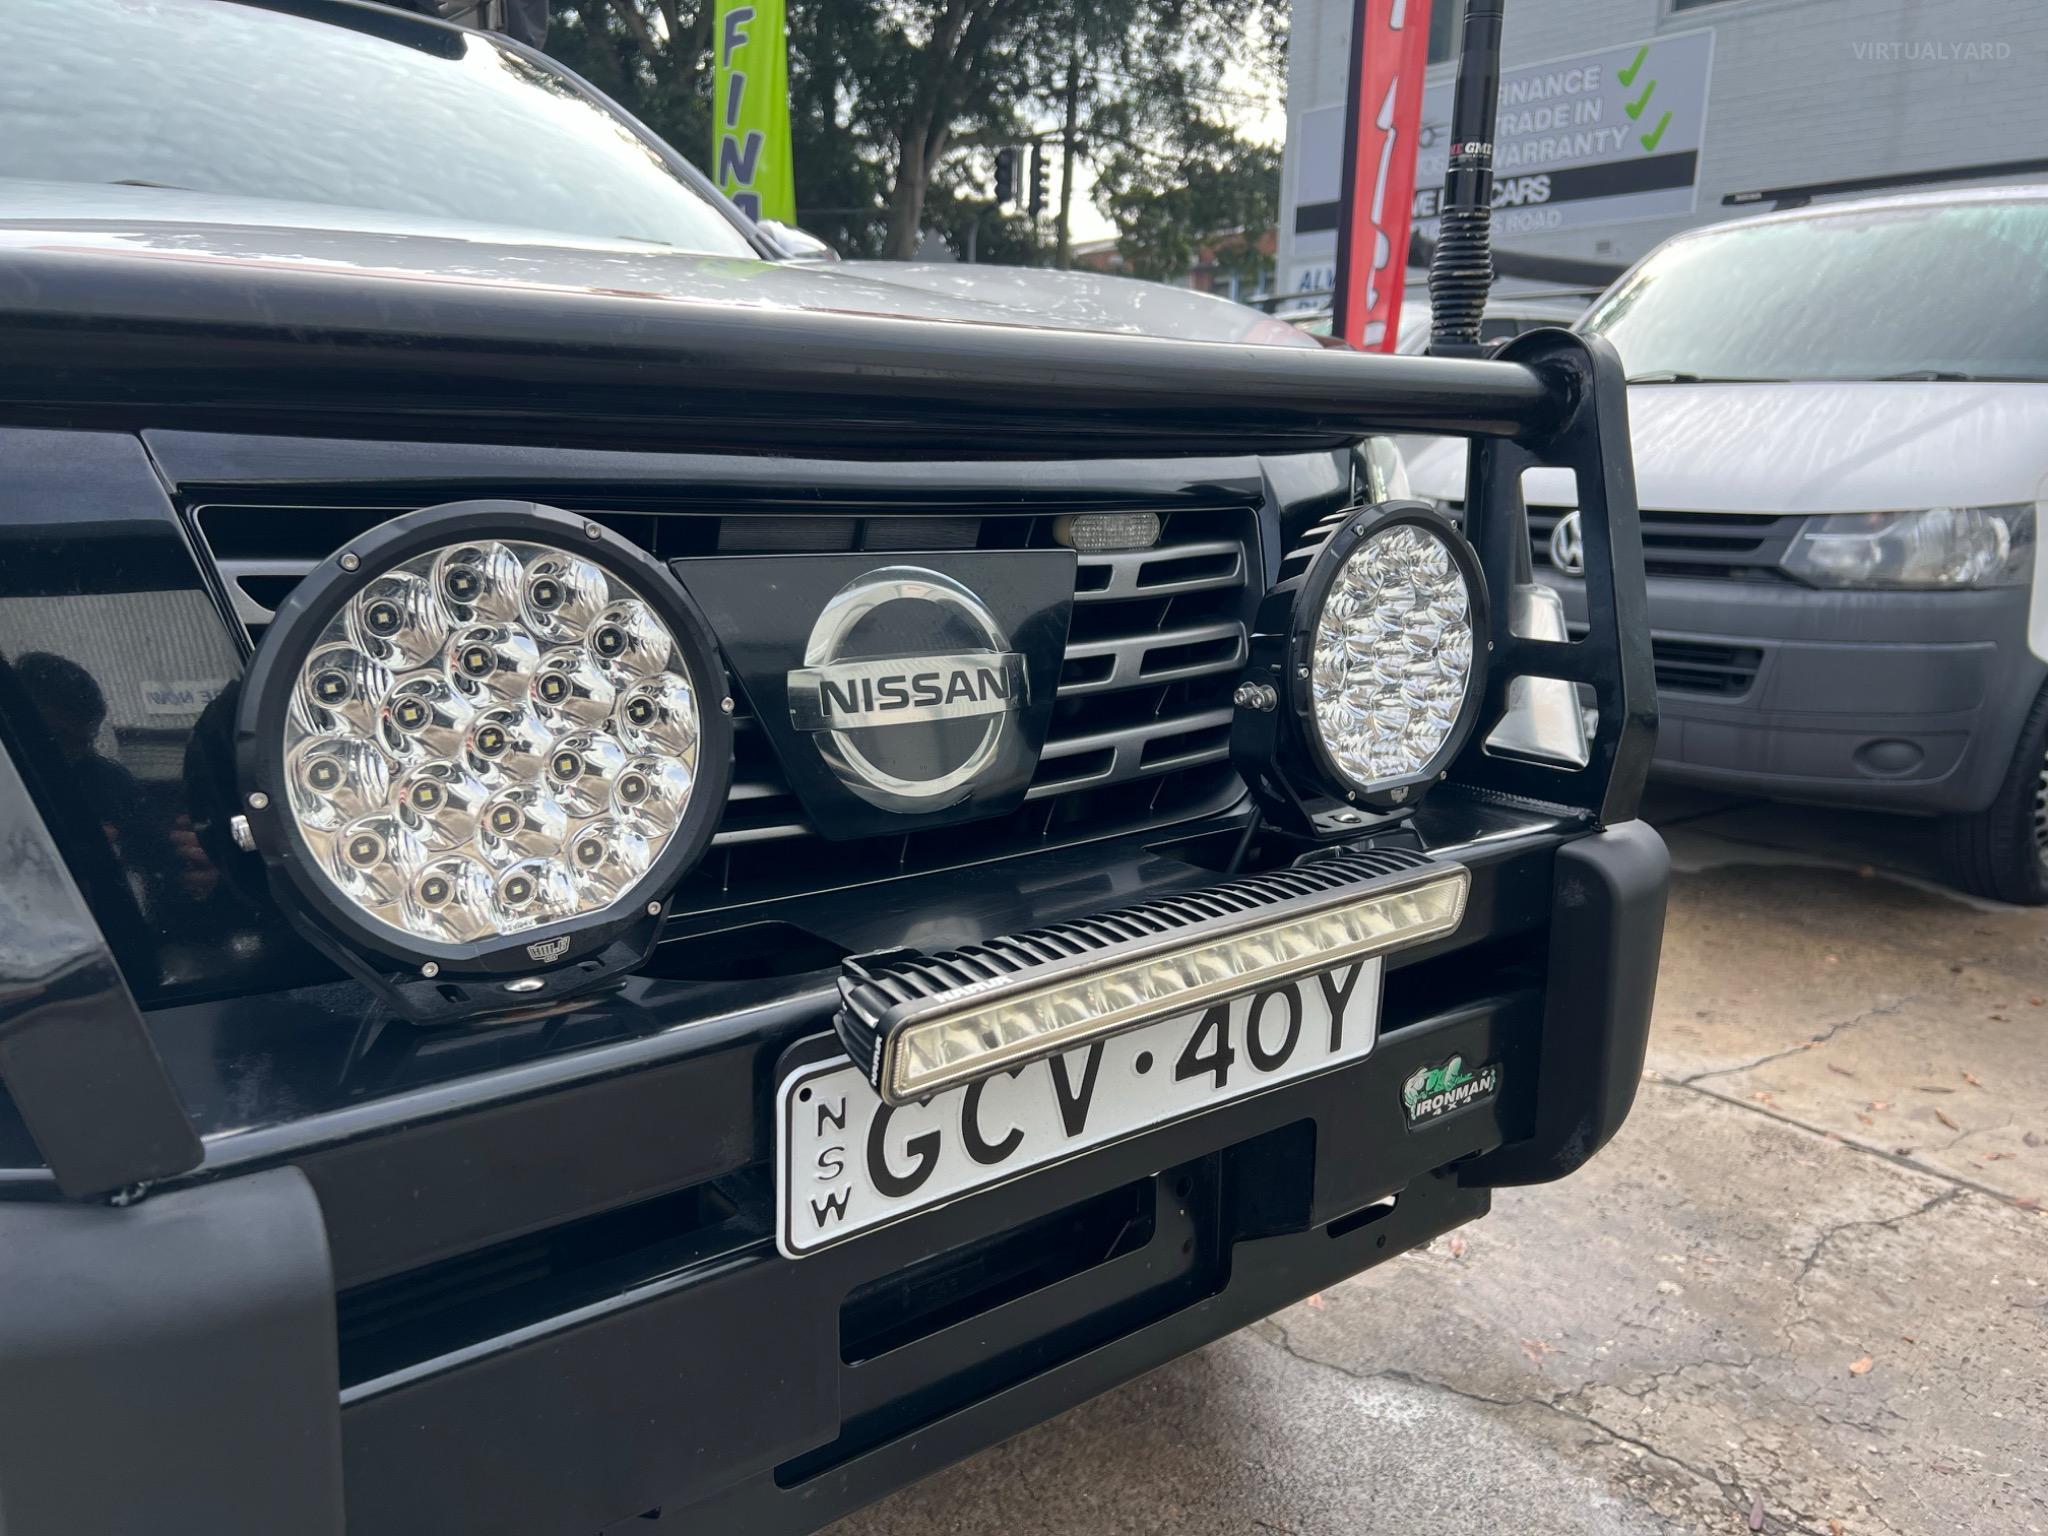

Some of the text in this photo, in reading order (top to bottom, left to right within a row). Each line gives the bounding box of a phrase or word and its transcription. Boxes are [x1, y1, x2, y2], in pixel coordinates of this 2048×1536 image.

[1499, 64, 1601, 106] INANCE
[1498, 97, 1603, 137] RADE IN
[1491, 175, 1551, 208] CARS
[819, 667, 1010, 717] NISSAN
[1415, 1075, 1491, 1118] IRONMAN
